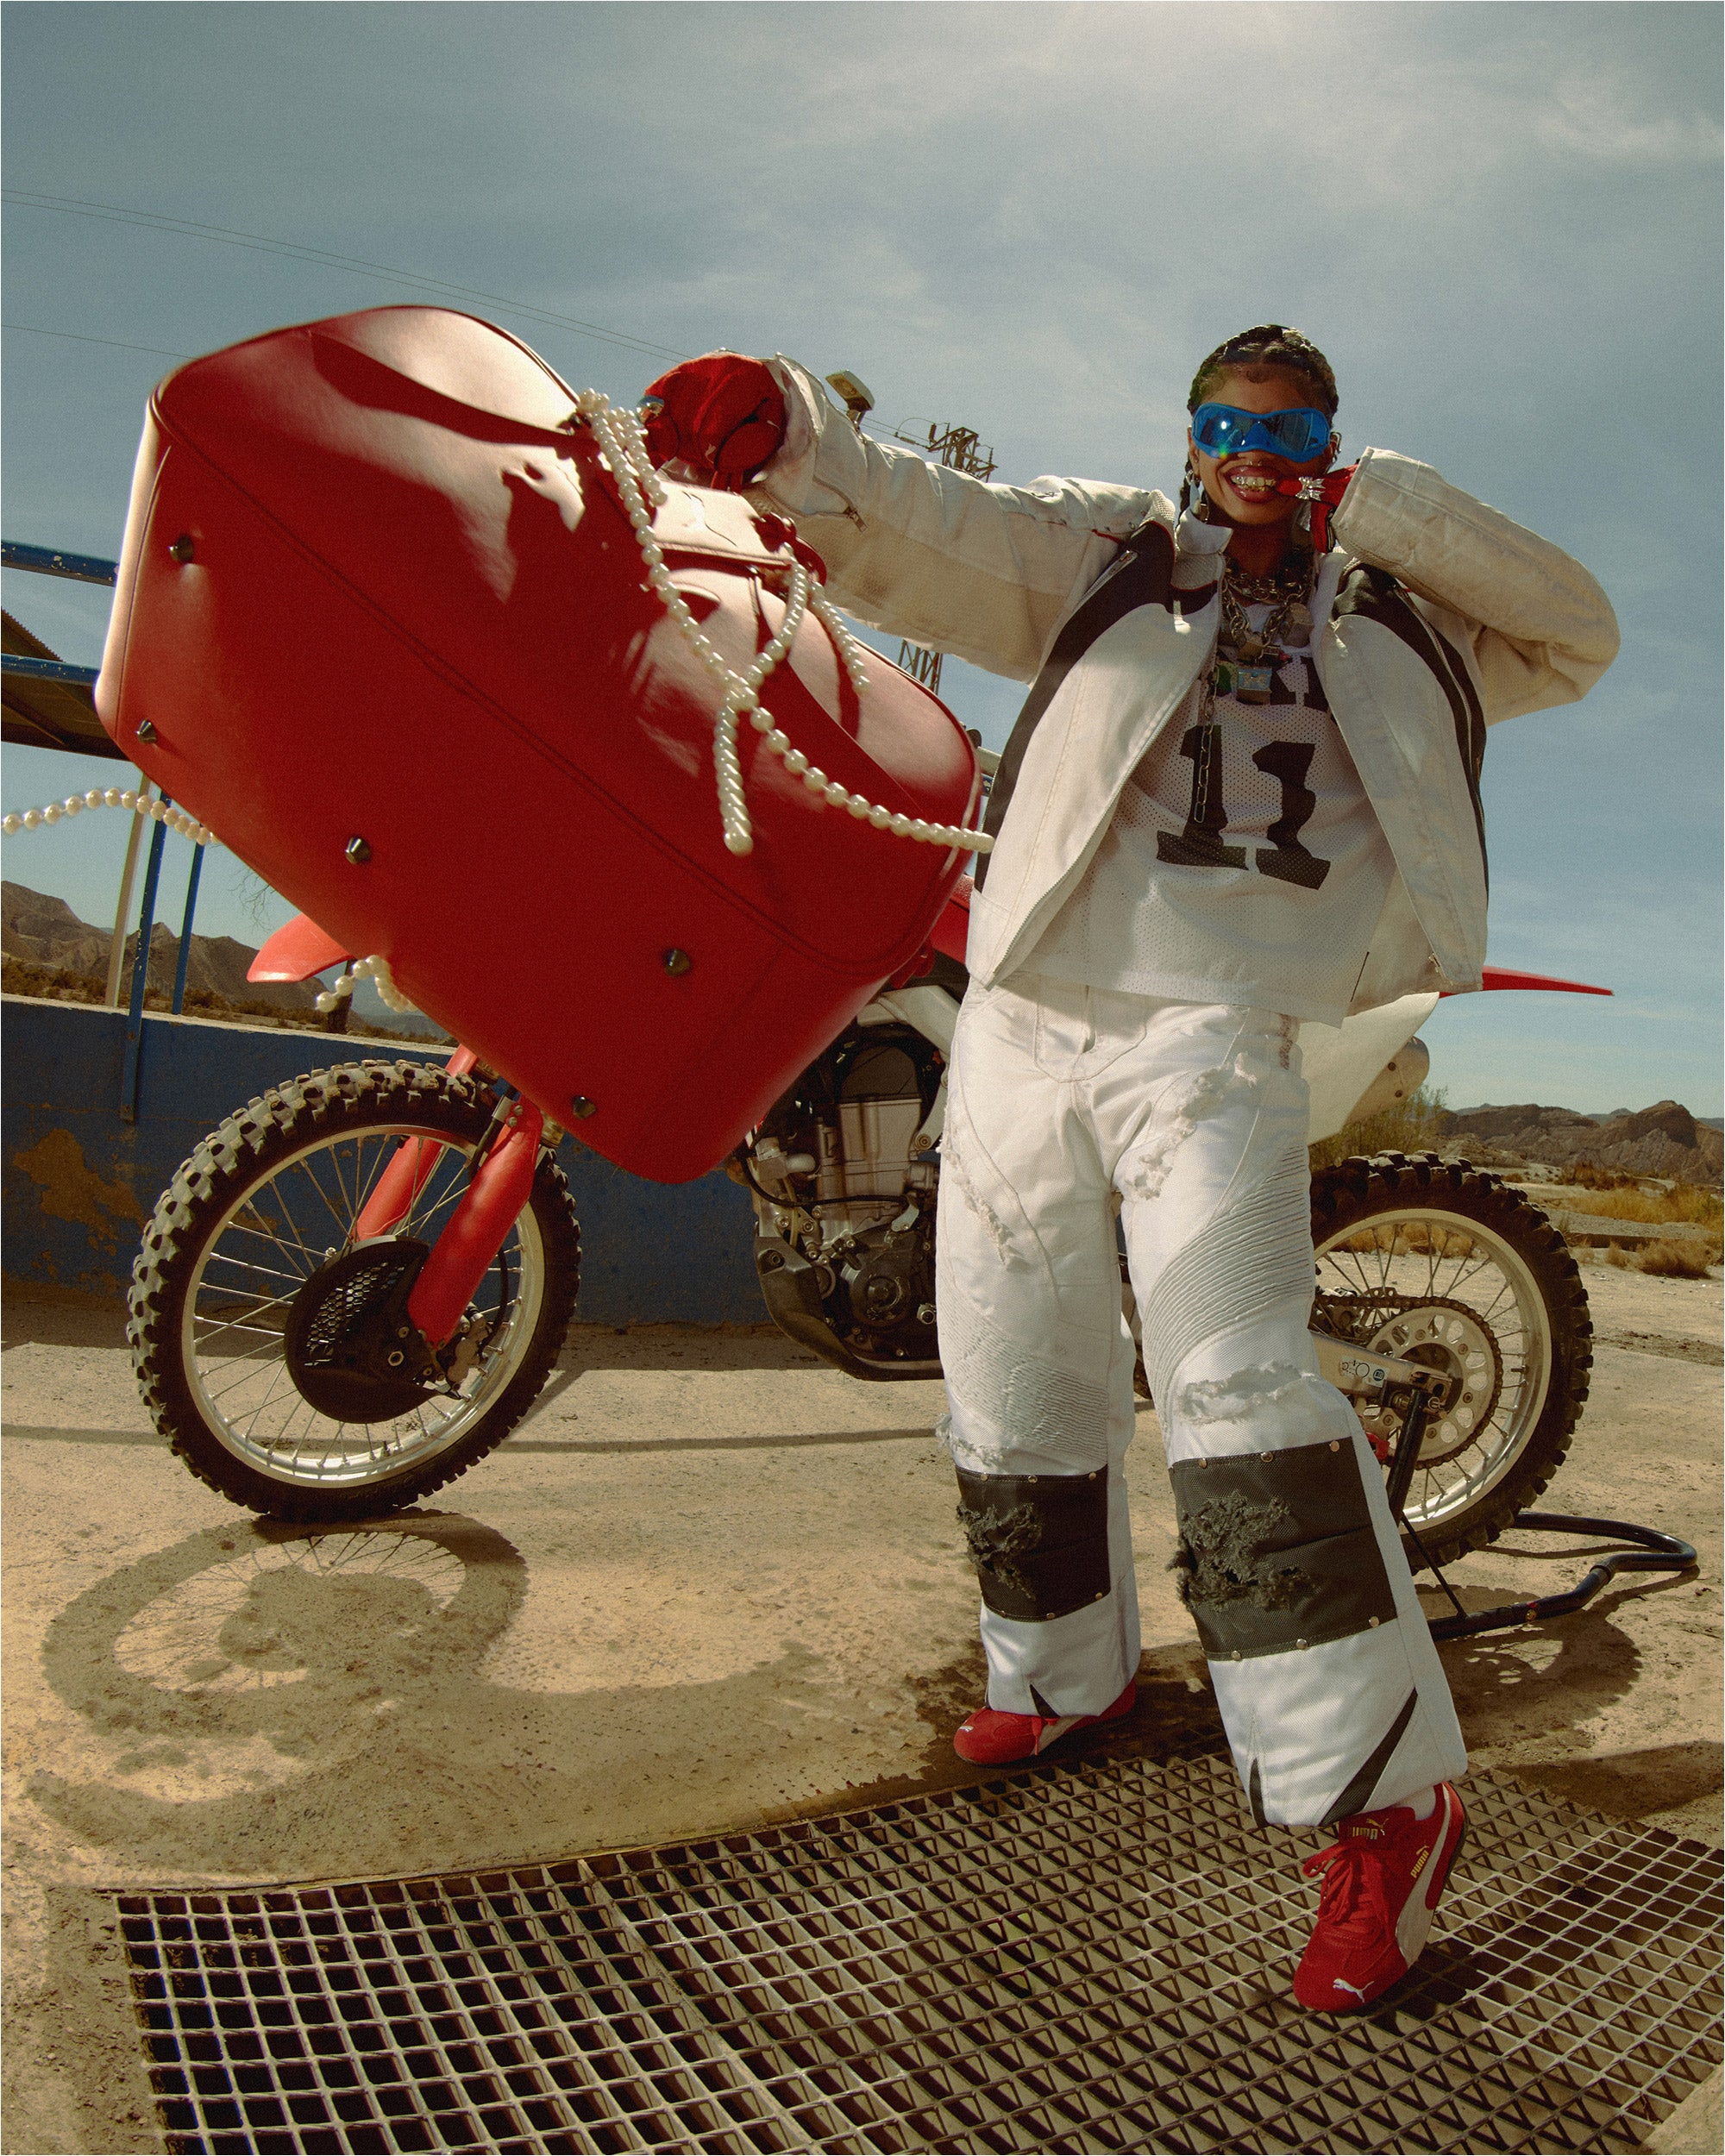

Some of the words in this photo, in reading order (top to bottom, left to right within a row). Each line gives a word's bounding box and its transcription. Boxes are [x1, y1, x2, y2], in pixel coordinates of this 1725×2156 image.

[1157, 724, 1331, 890] 11
[1347, 1827, 1378, 1839] UMA
[1410, 1850, 1429, 1878] PUMA
